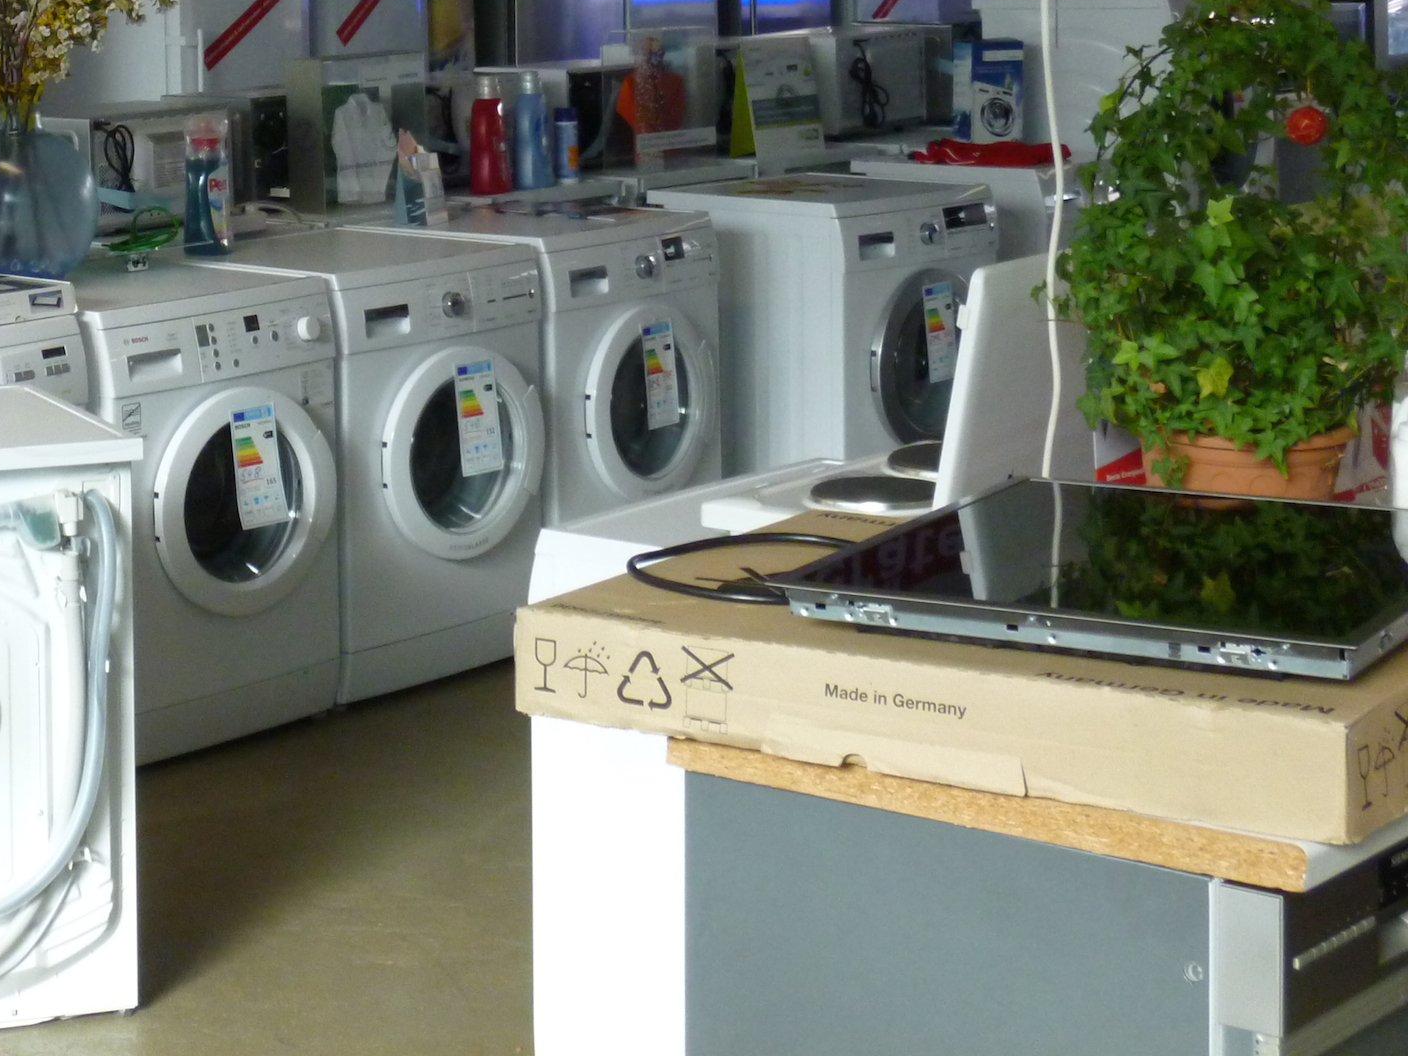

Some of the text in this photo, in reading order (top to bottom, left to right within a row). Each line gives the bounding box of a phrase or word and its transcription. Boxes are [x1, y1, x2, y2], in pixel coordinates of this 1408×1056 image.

[131, 336, 149, 344] BOSCH
[234, 422, 251, 431] BOSCH
[824, 682, 967, 720] Made in Germany
